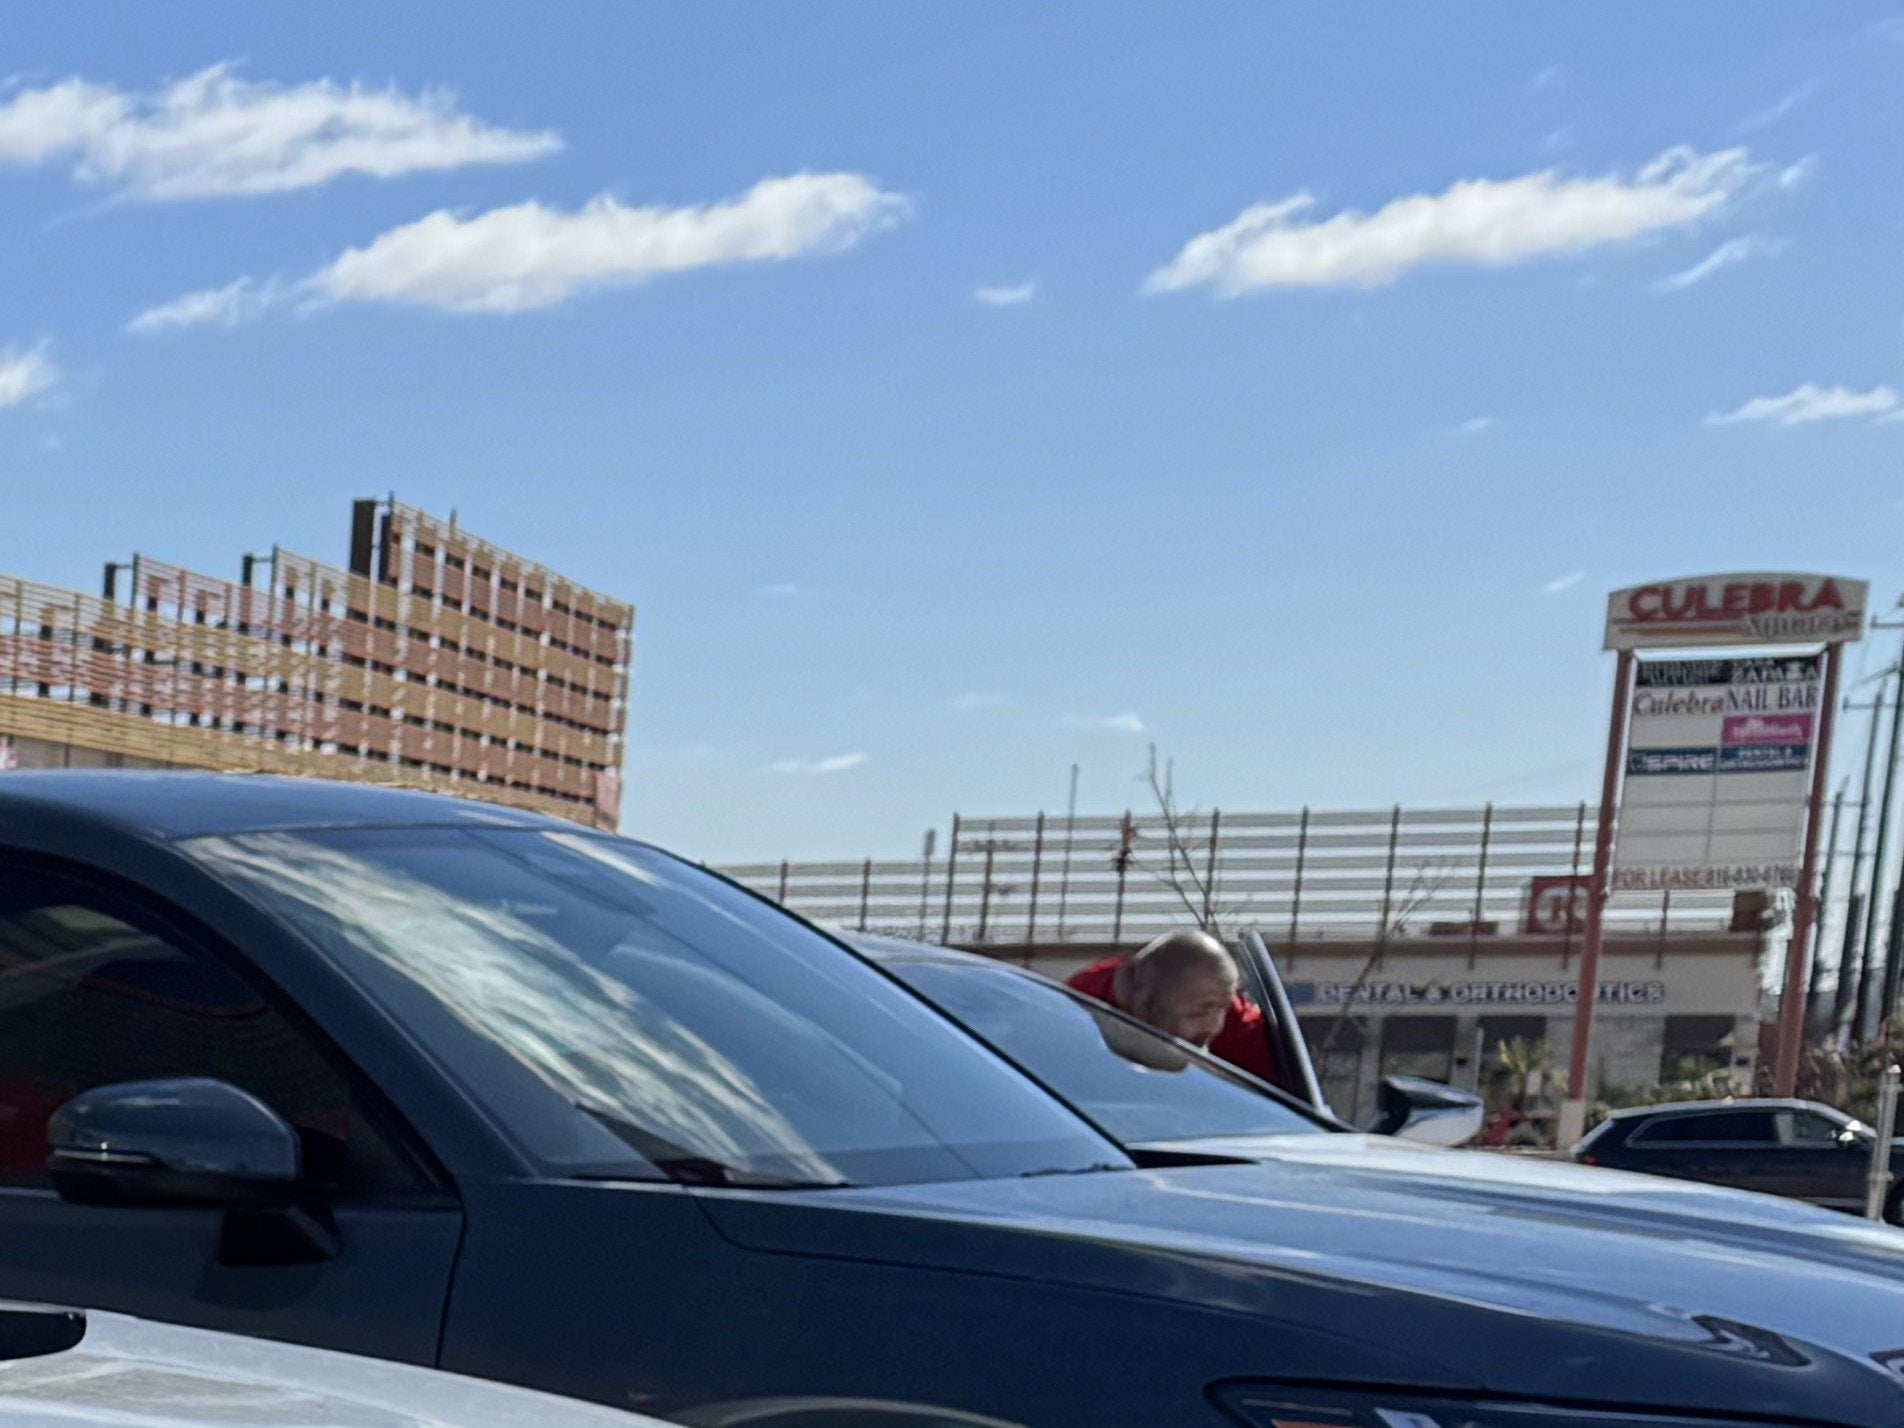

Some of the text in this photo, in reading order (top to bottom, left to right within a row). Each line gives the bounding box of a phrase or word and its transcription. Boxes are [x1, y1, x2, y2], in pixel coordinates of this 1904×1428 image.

[1628, 578, 1843, 620] CULEBRA
[1319, 982, 1420, 1003] DENTAL
[1450, 981, 1666, 1004] ORTHODOTICS
